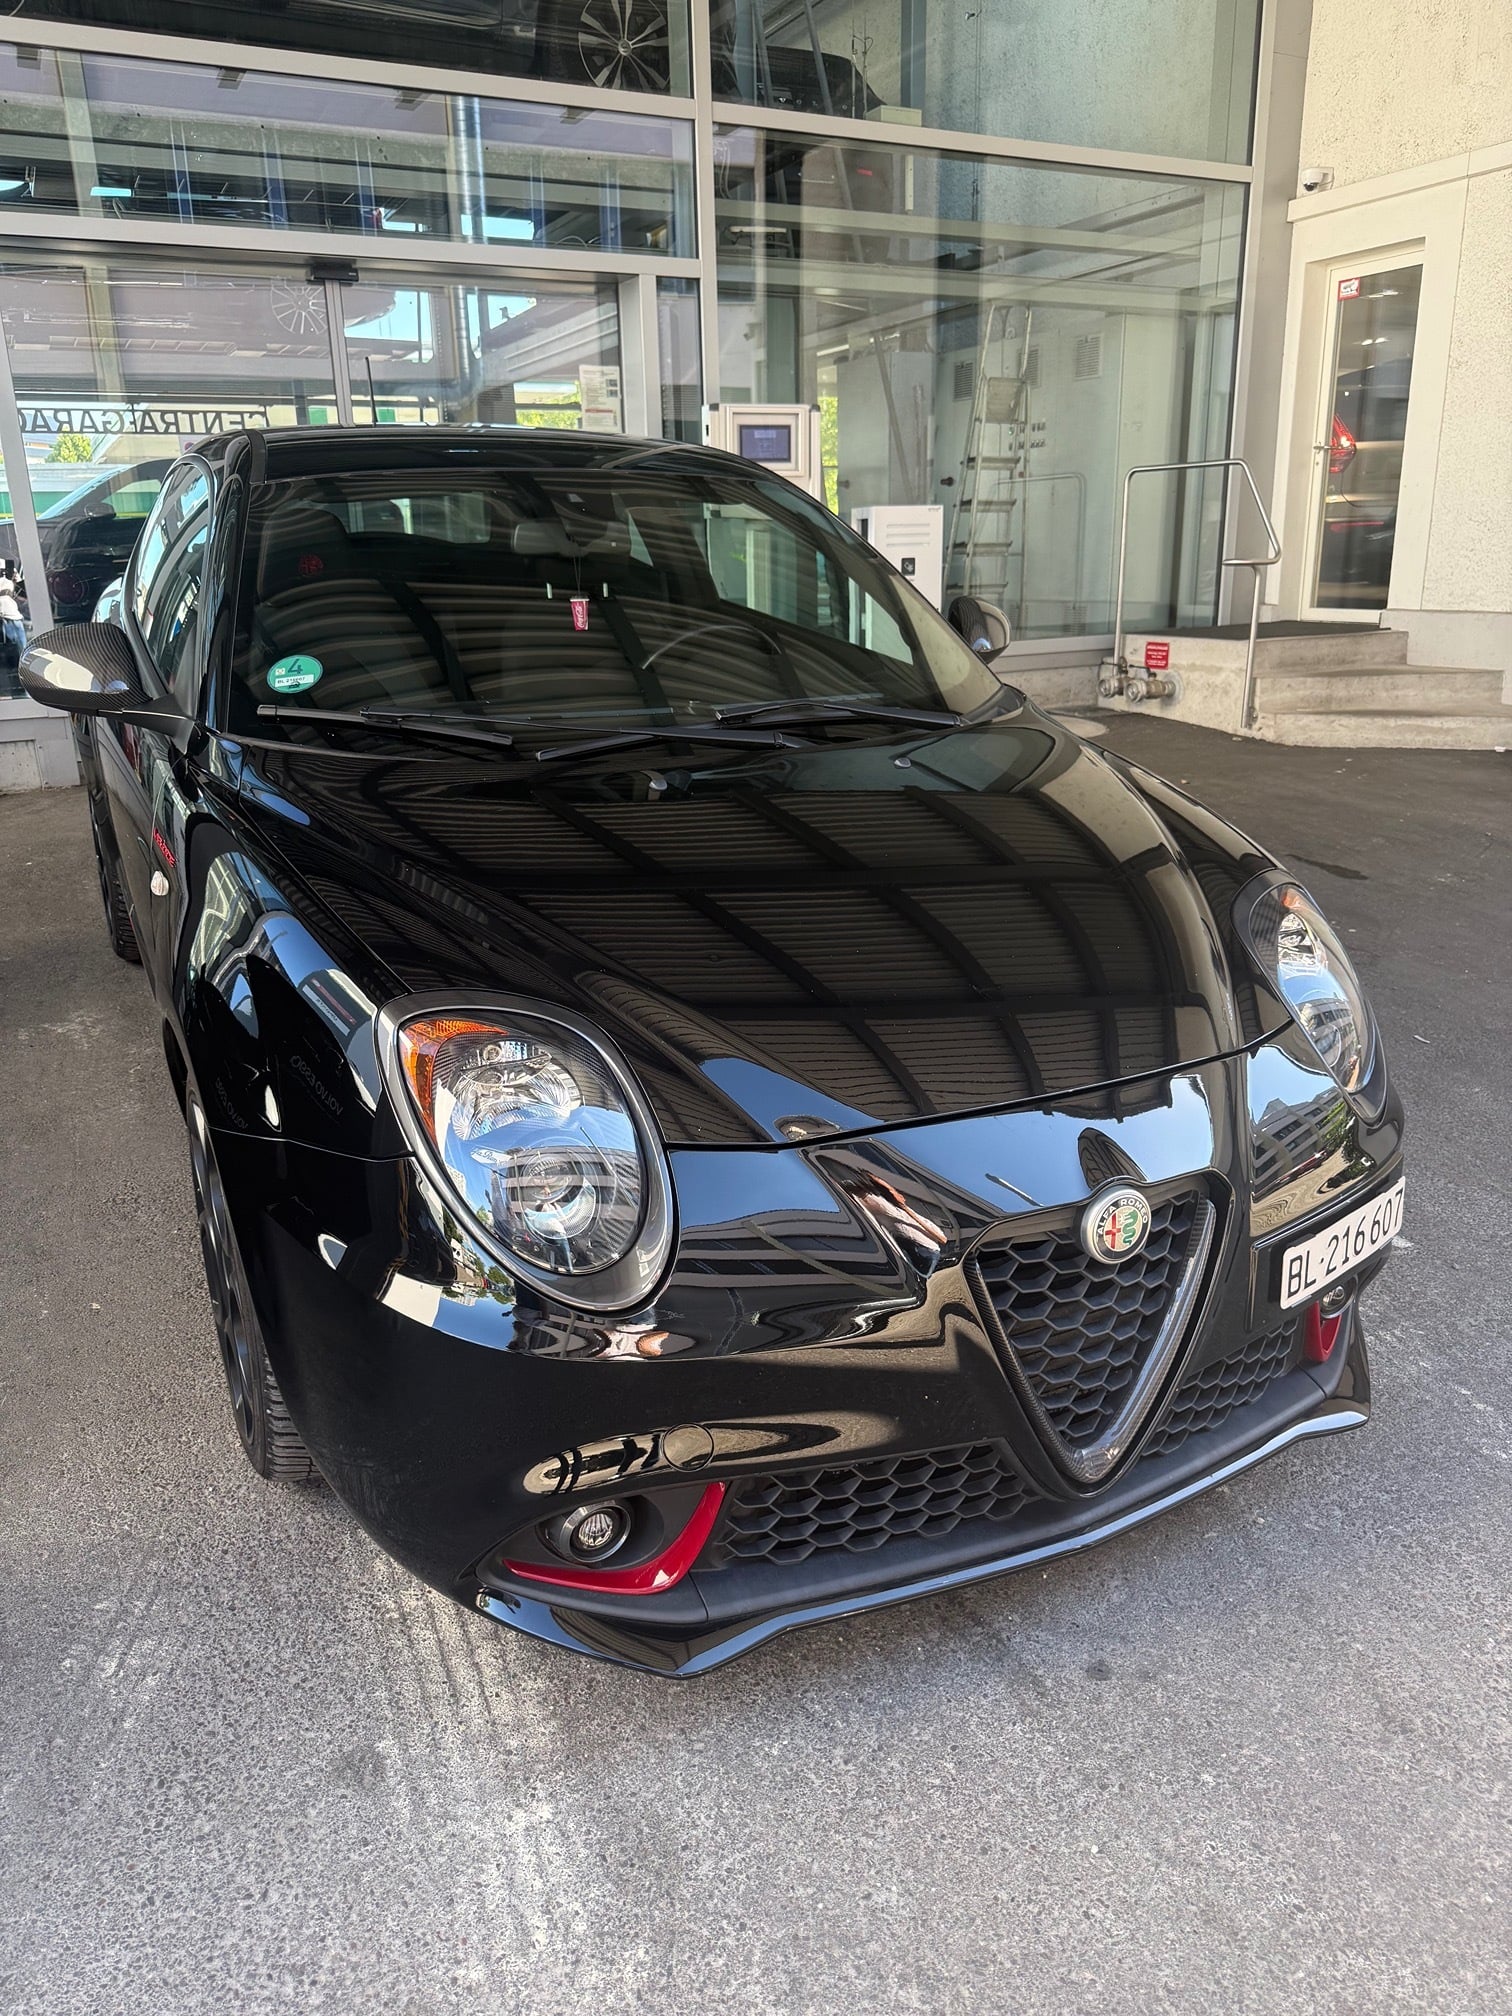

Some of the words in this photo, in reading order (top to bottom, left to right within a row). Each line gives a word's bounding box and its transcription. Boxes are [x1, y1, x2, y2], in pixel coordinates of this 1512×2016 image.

[288, 658, 303, 674] 4
[1097, 1205, 1117, 1235] ALFA
[1120, 1198, 1148, 1224] ROMEO
